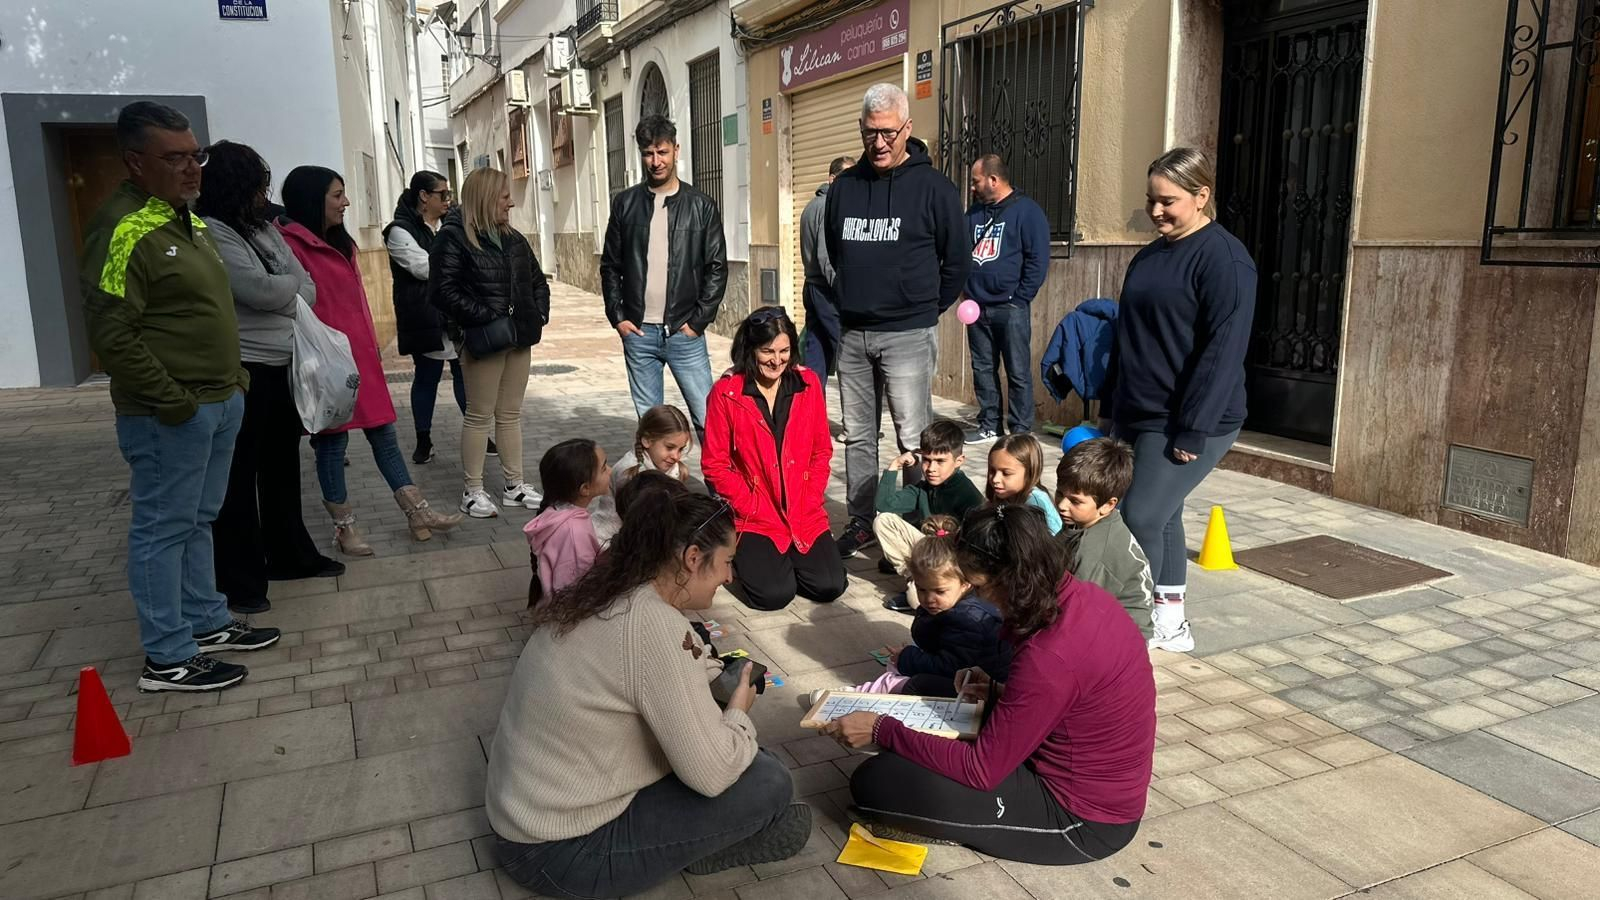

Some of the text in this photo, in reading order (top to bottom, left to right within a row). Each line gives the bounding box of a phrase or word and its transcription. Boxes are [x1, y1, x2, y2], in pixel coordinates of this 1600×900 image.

[840, 13, 883, 46] peluquería
[794, 43, 842, 75] Lilian
[847, 39, 875, 60] canina
